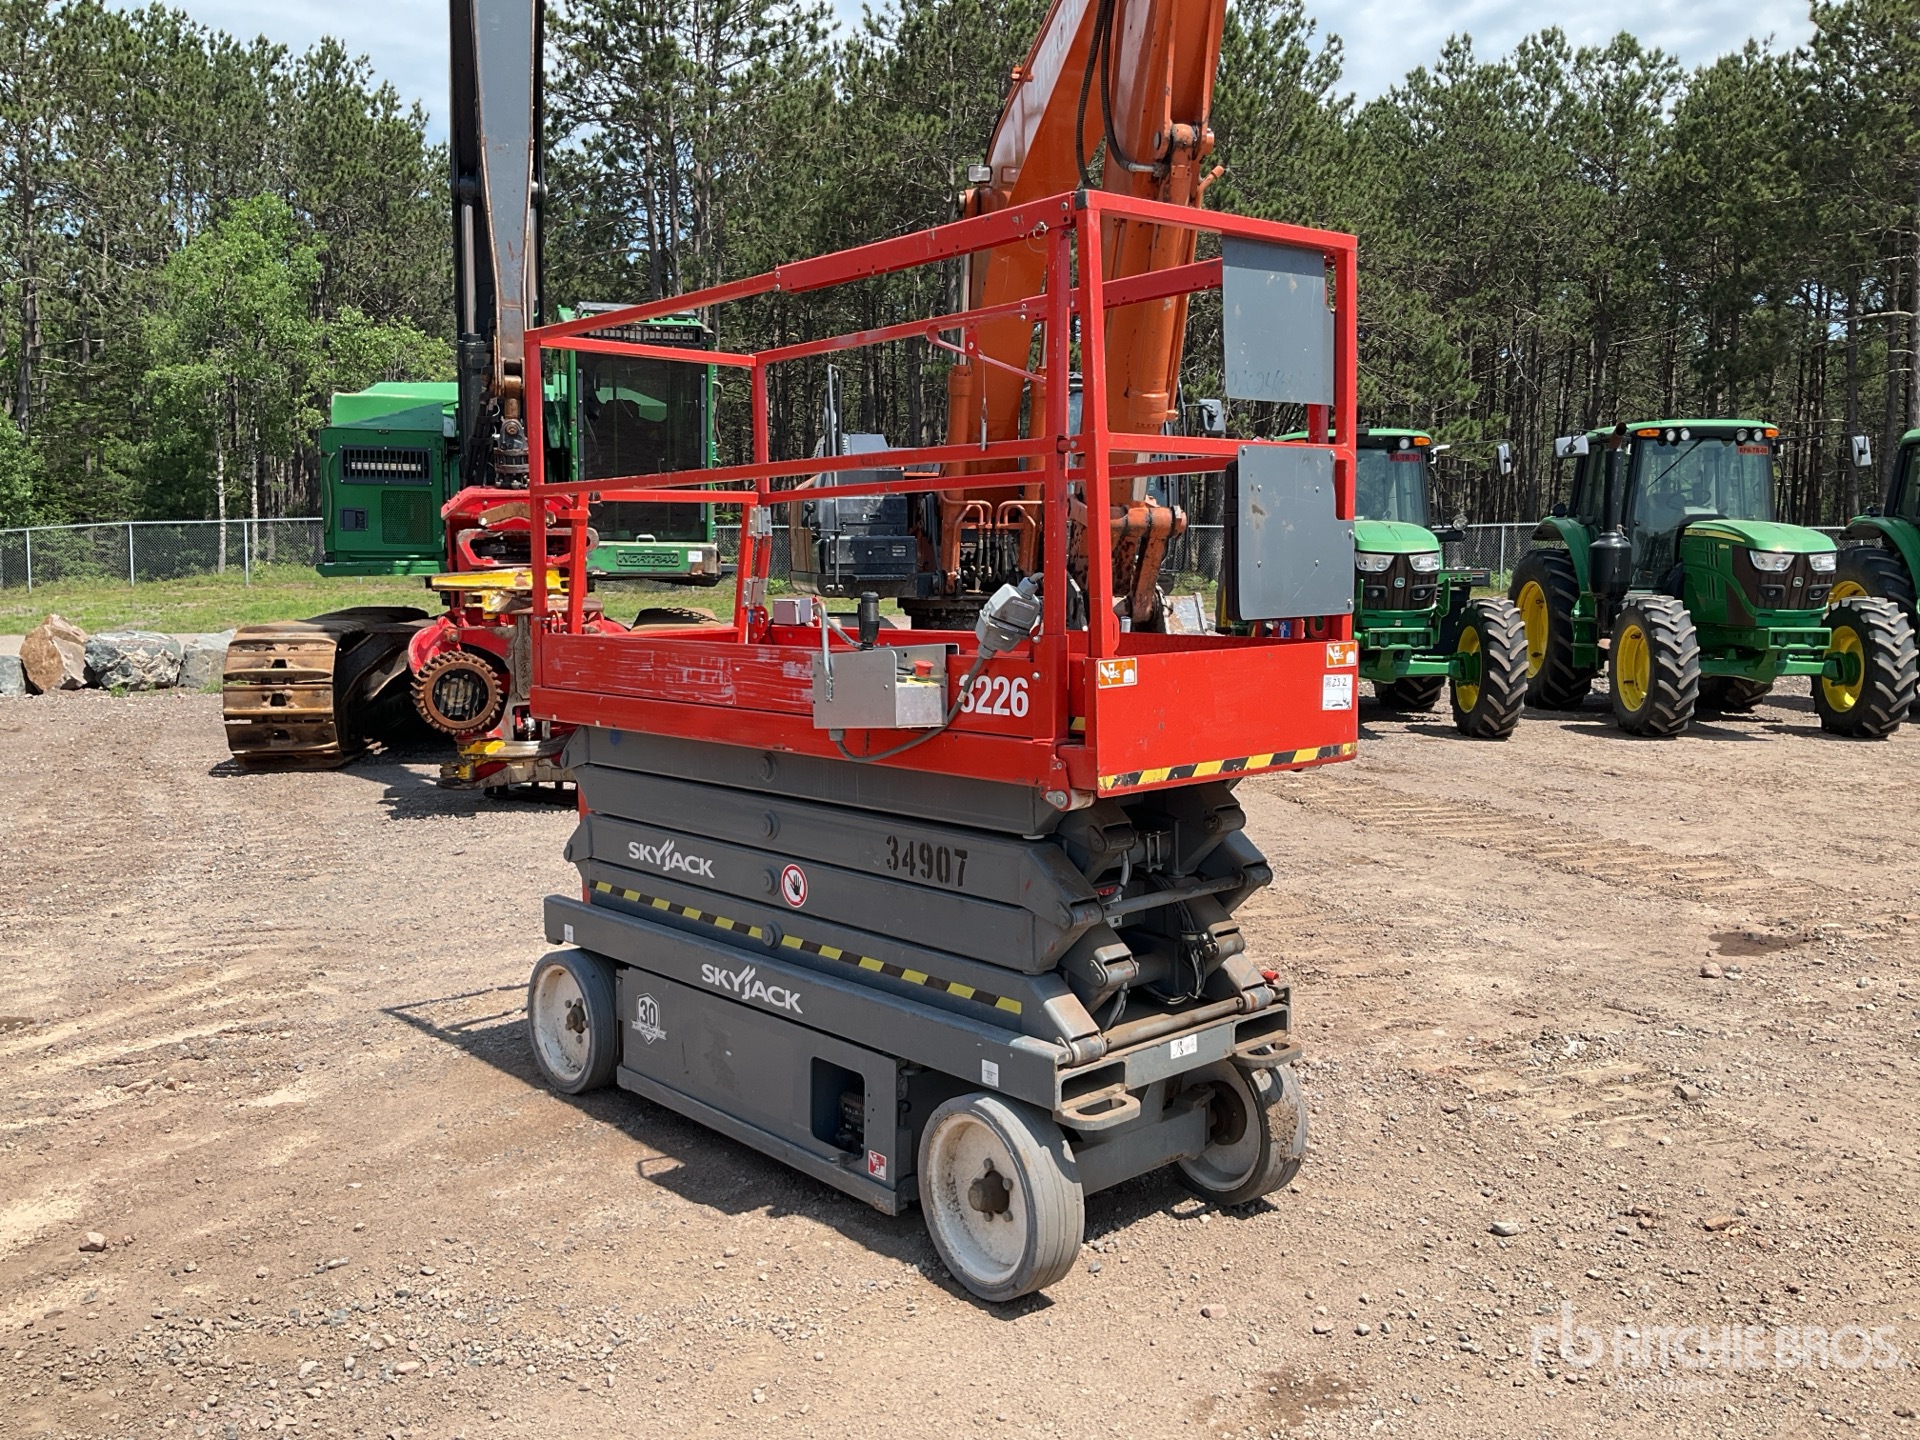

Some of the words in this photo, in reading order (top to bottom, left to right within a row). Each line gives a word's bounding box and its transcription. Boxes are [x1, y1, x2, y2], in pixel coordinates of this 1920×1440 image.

[619, 554, 678, 564] NORTRAX
[958, 674, 1029, 718] 3226
[628, 839, 715, 879] SKYJACK
[886, 835, 968, 887] 34907
[701, 964, 803, 1014] SKYJACK
[640, 999, 657, 1026] 30
